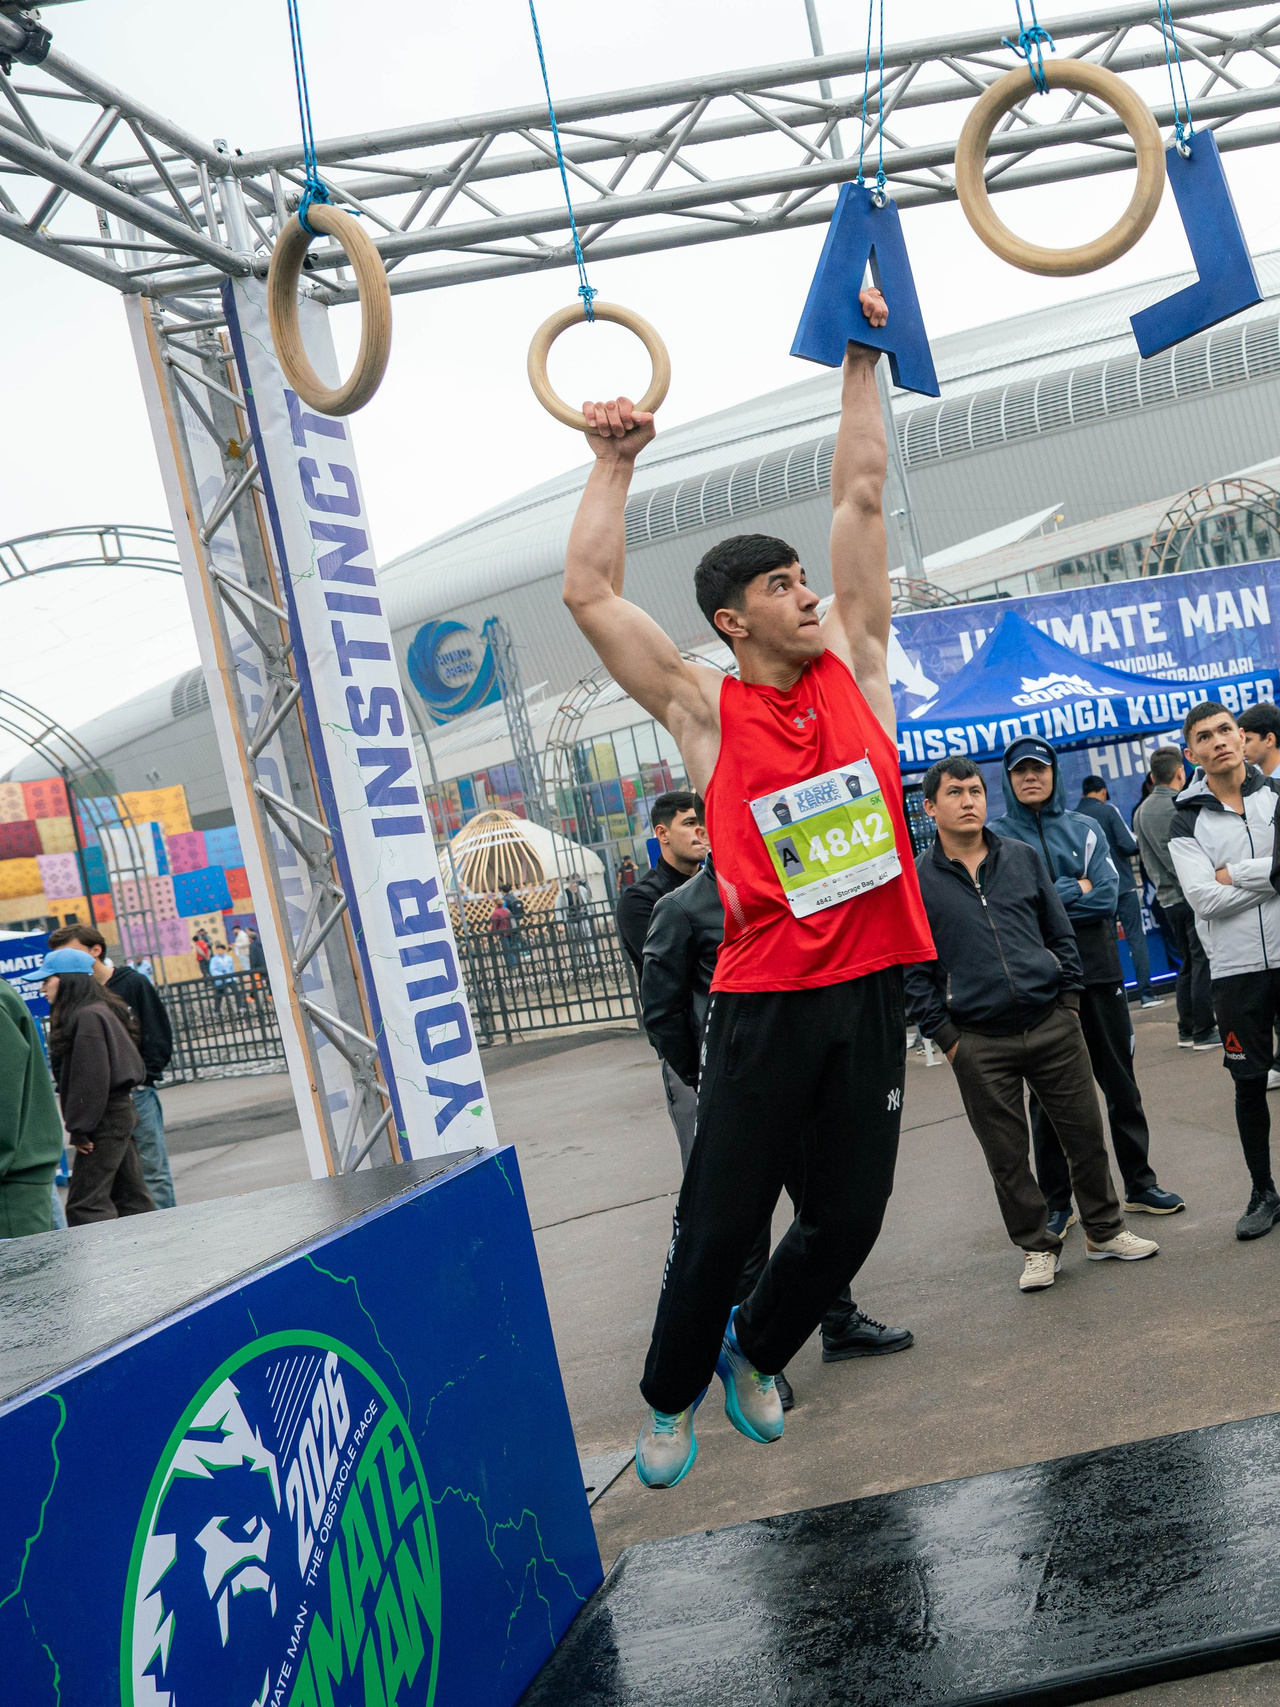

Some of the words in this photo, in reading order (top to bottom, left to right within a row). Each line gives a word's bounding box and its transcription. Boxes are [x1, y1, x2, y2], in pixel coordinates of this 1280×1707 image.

[284, 388, 425, 838] INSTINCT
[1178, 585, 1271, 638] MAN
[896, 698, 1119, 763] HISSIYOTINGA
[1218, 678, 1275, 714] BER
[1012, 683, 1125, 707] GORILLA
[794, 781, 833, 802] TASH
[797, 791, 834, 810] KENT
[870, 794, 882, 806] 5K
[782, 847, 800, 868] A
[808, 812, 890, 864] 4842
[816, 895, 833, 907] 4842
[837, 884, 860, 898] Storage
[861, 878, 875, 892] Bag
[389, 876, 484, 1137] YOUR
[285, 1350, 351, 1579] 2026
[305, 1547, 324, 1588] THE
[320, 1450, 357, 1543] OBSTACLE
[353, 1399, 379, 1451] RACE
